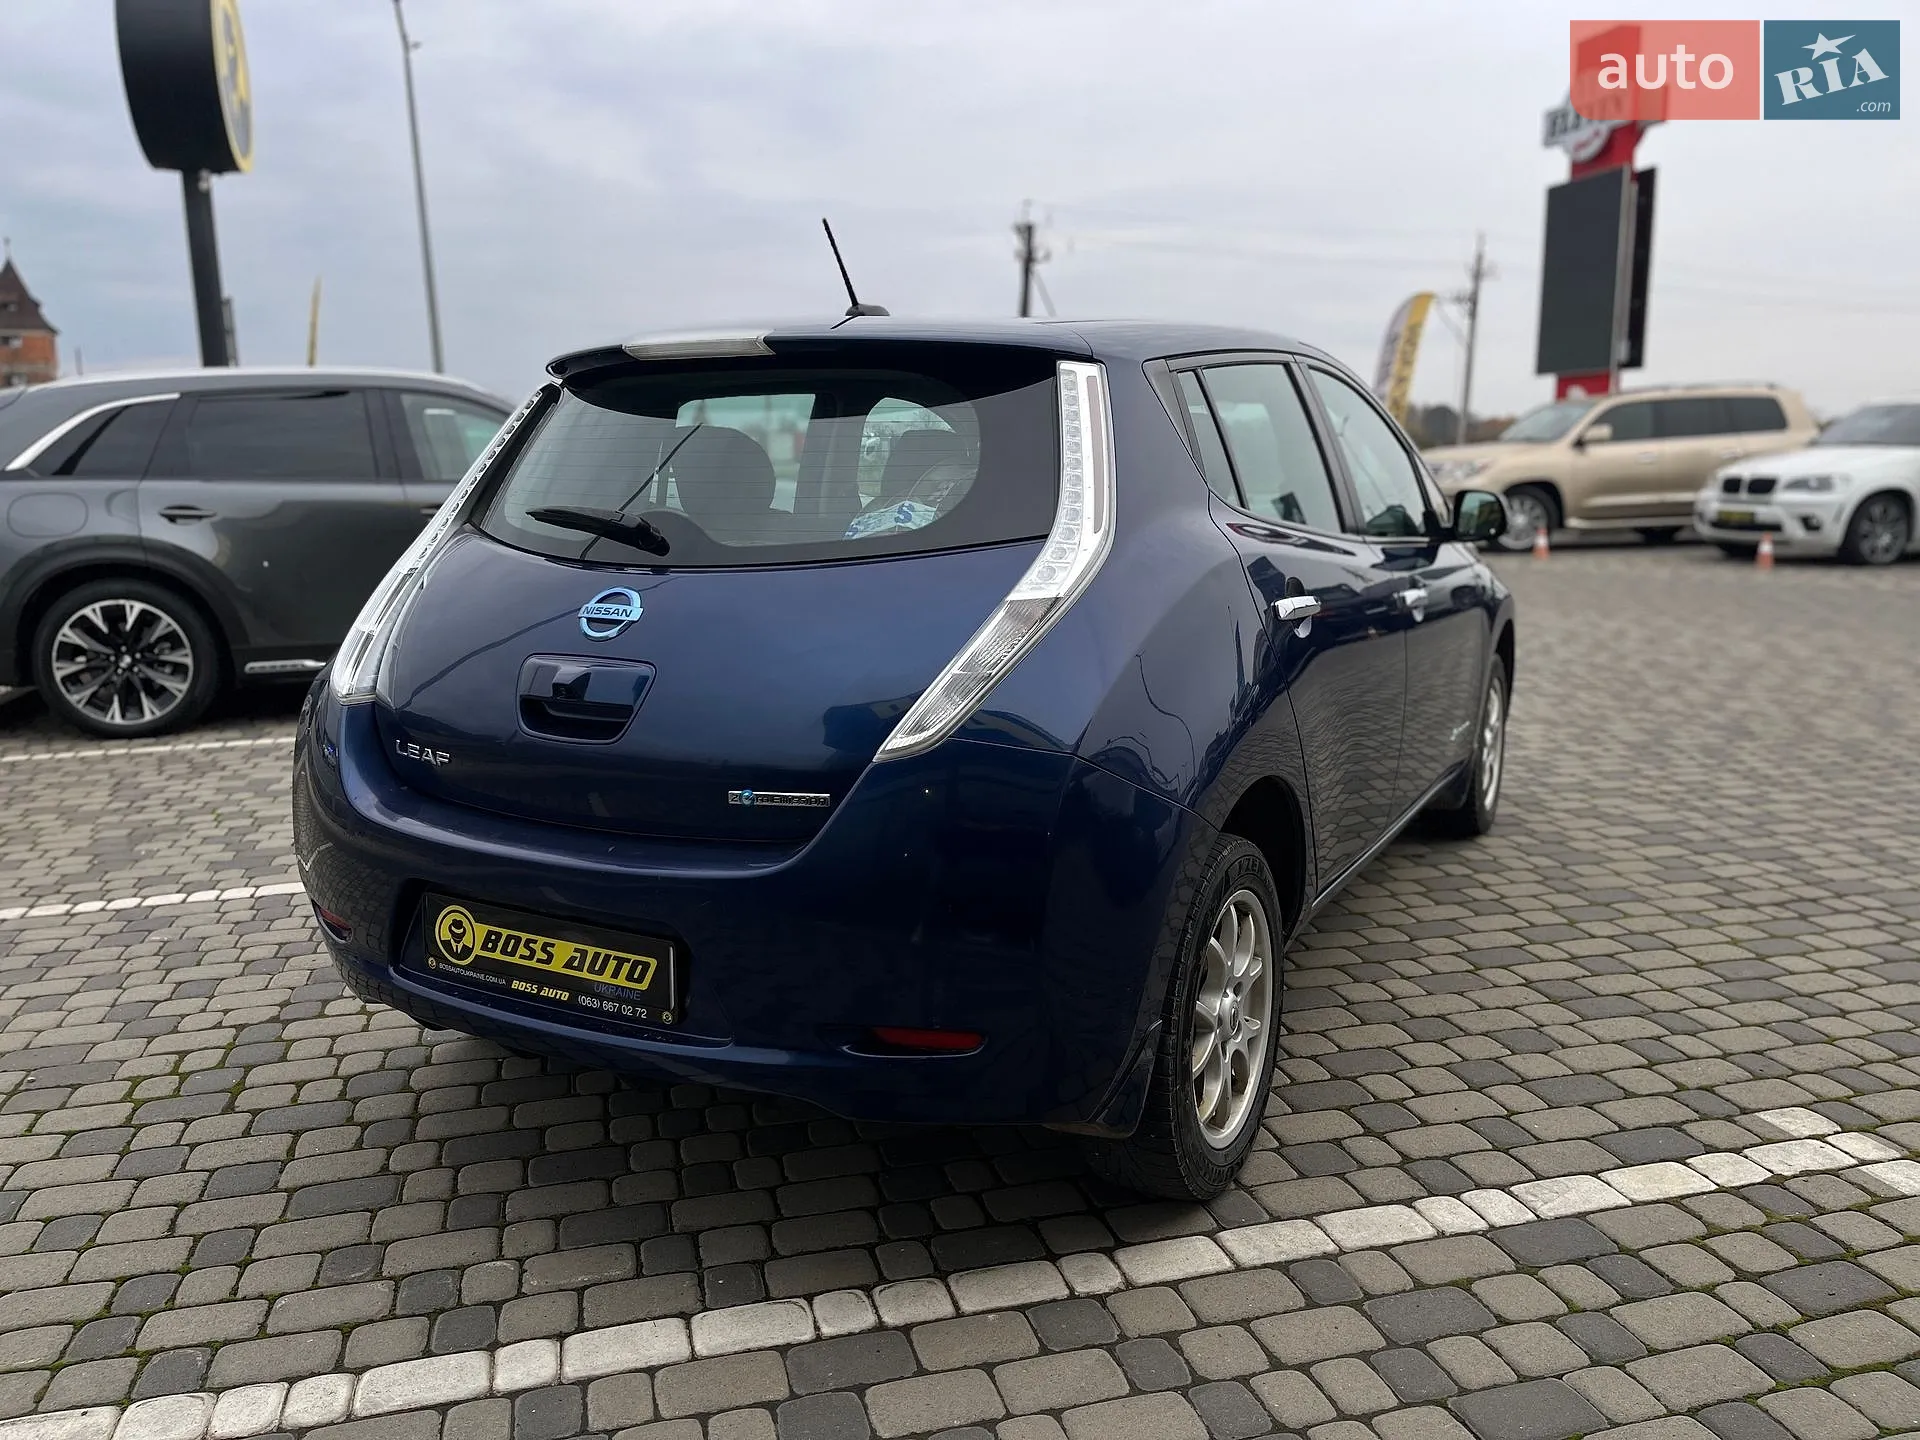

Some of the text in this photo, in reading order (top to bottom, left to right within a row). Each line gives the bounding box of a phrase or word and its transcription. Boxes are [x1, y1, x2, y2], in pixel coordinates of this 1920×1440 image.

[583, 606, 632, 618] NISSAN
[396, 740, 450, 766] LEAF
[480, 929, 652, 985] BOSS AUTO
[511, 980, 569, 1001] BOSS AUTO
[594, 983, 641, 1000] UKRAINE
[578, 995, 647, 1019] (063) 667 02 72
